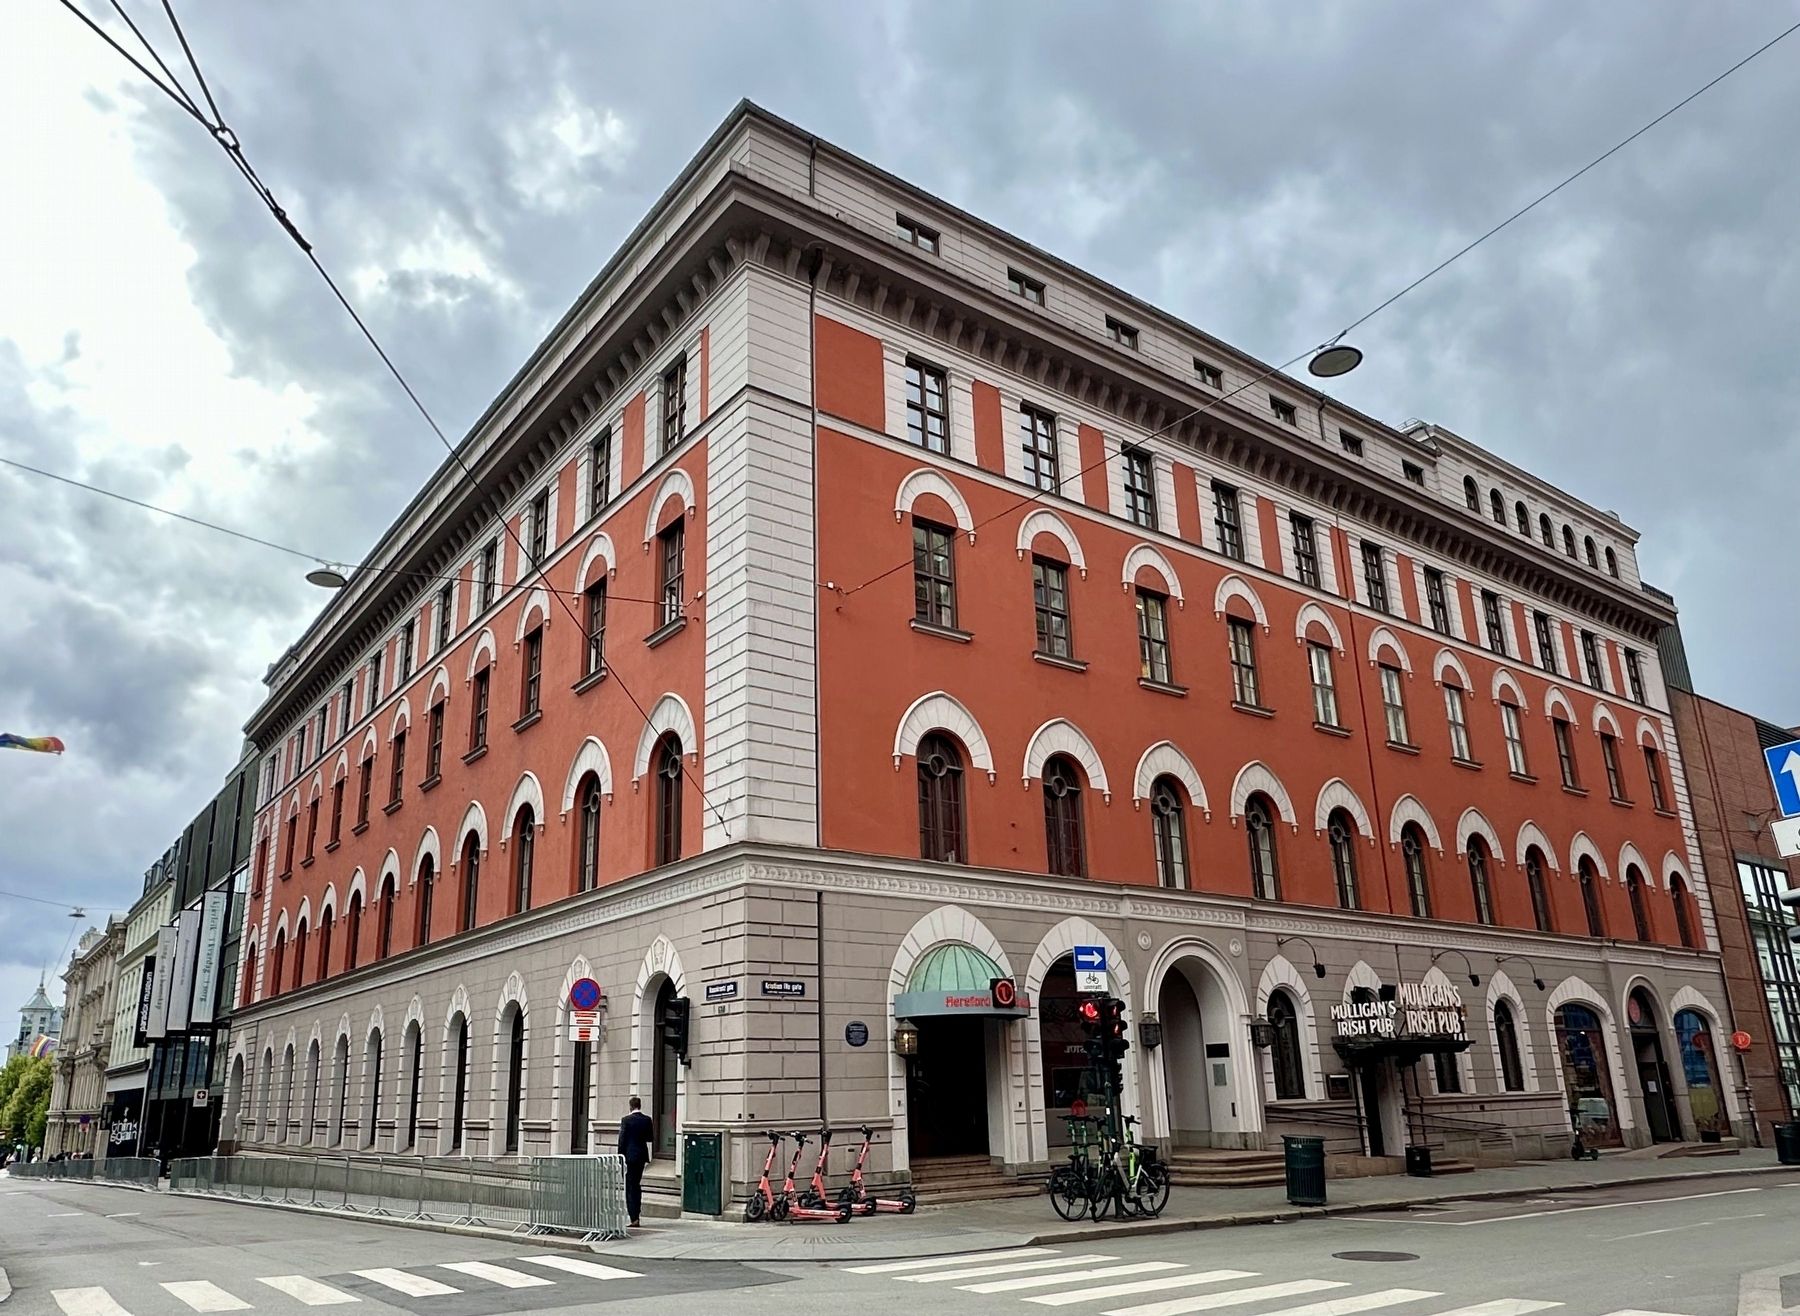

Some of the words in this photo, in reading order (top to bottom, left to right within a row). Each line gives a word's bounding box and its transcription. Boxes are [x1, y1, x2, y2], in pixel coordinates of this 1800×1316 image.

[139, 1002, 149, 1032] paradox
[144, 971, 153, 1003] museum
[1399, 983, 1462, 1007] MULLIGAN'S
[1330, 1000, 1397, 1020] MULLIGAN'S
[1406, 1010, 1437, 1033] IRISH
[1440, 1011, 1461, 1034] PUB
[1337, 1020, 1367, 1036] IRISH
[1370, 1018, 1394, 1034] PUB
